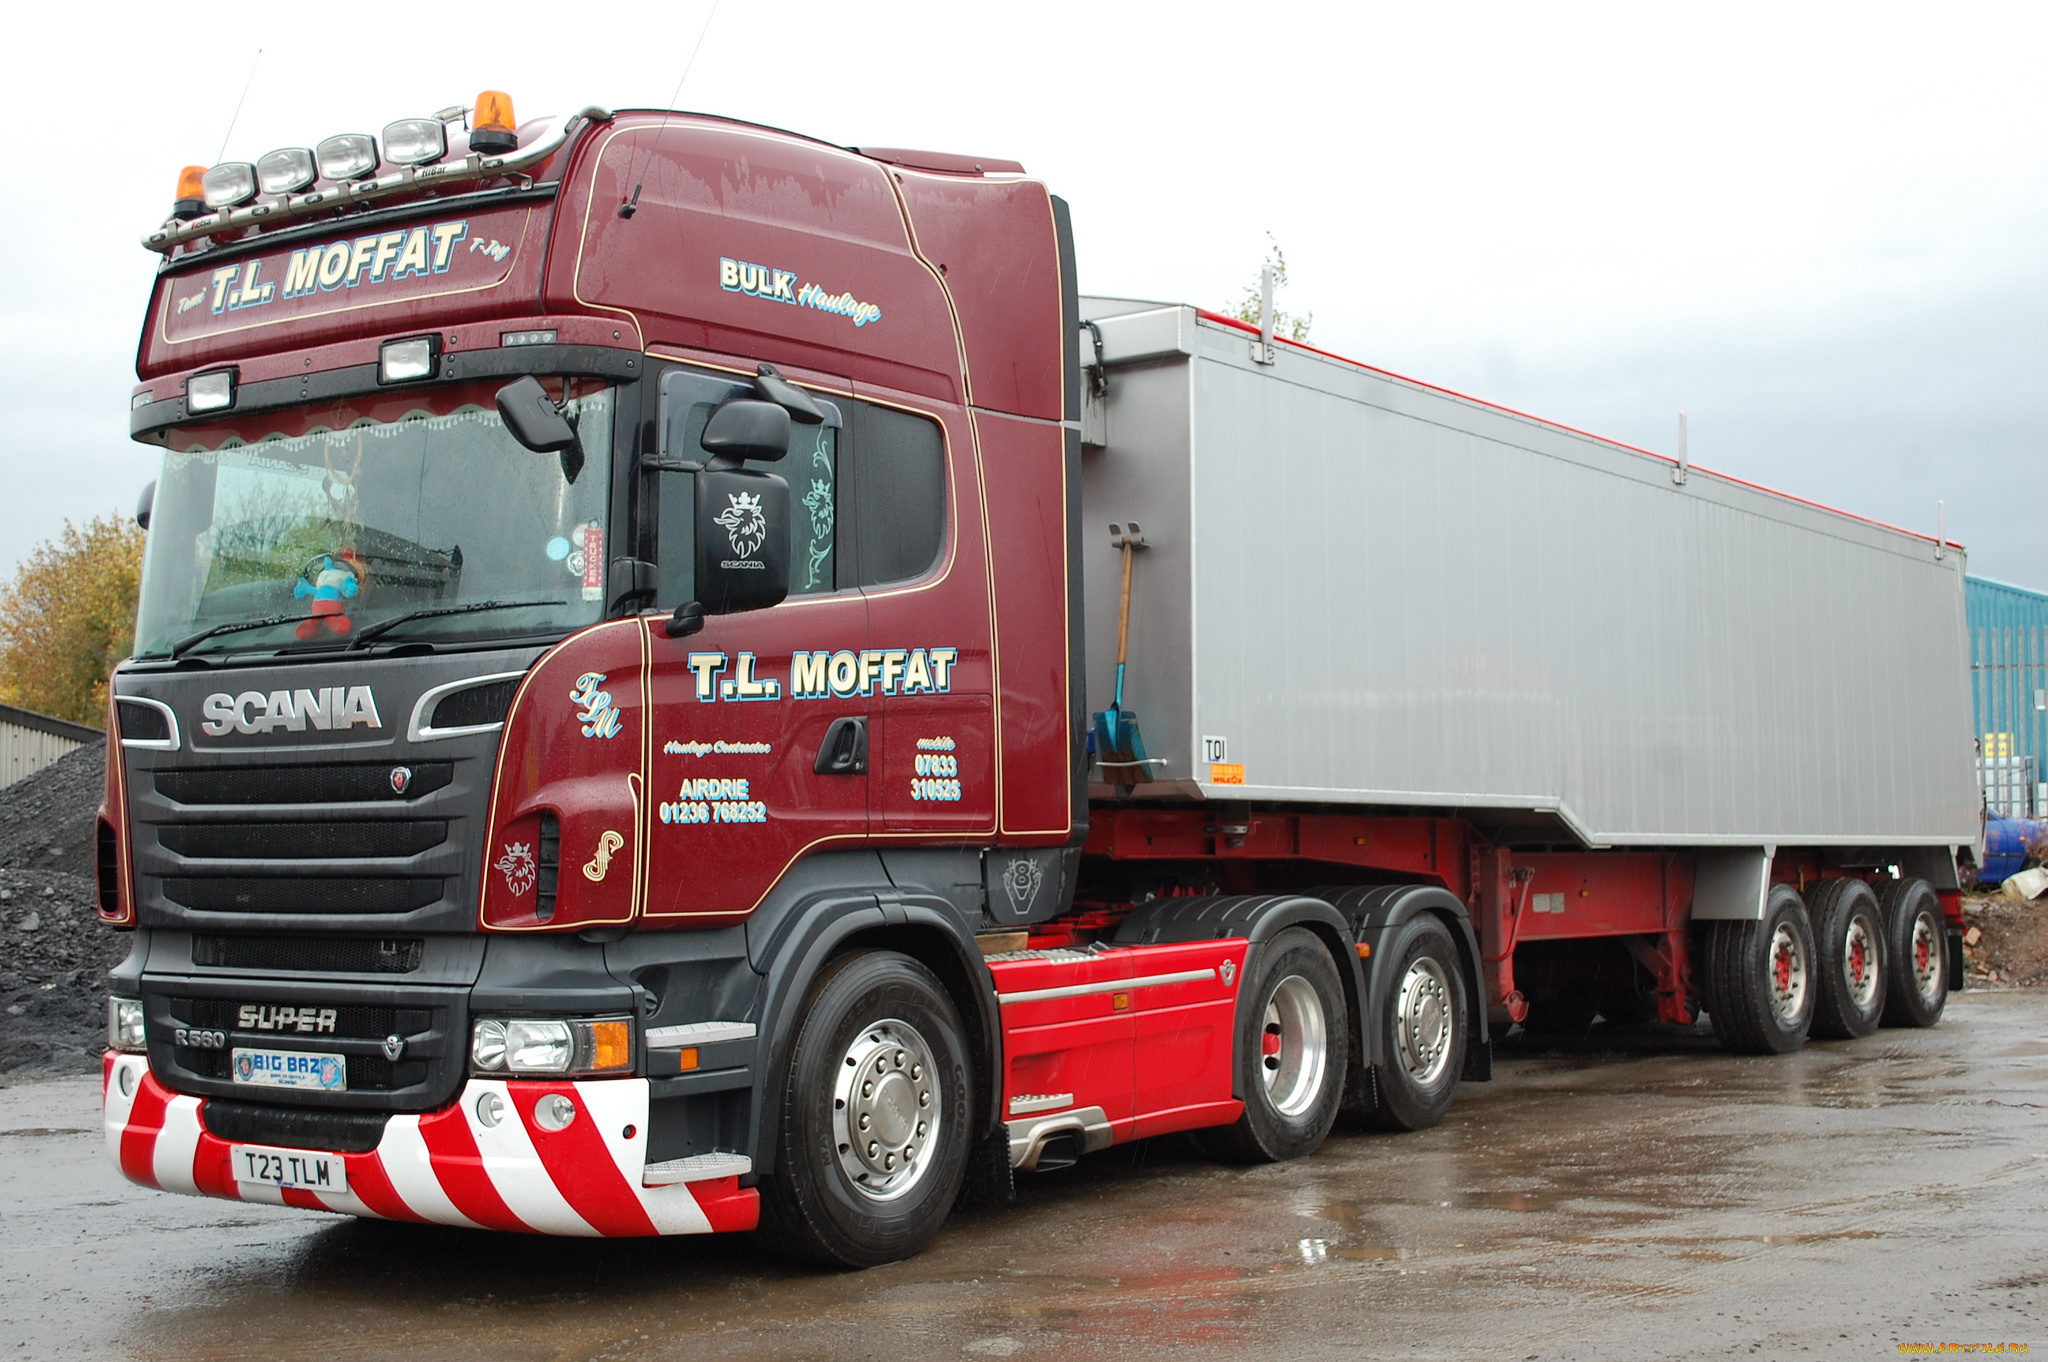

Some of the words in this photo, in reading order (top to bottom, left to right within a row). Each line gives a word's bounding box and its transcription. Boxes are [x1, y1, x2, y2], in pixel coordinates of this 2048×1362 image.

[212, 260, 276, 315] T.L.
[282, 220, 468, 299] MOFFAT
[720, 257, 797, 305] BULK
[798, 282, 881, 327] Haulage
[588, 534, 598, 583] TRUCKER
[720, 560, 766, 569] SCANIA
[688, 651, 781, 703] T.L.
[790, 646, 958, 699] MOFFAT
[202, 685, 382, 737] SCANIA
[916, 736, 956, 751] mobile
[914, 754, 958, 777] 07833
[679, 778, 750, 800] AIRDRIE
[910, 778, 961, 801] 310525
[659, 801, 710, 824] 01236
[711, 801, 767, 824] 768252
[238, 1004, 337, 1033] SUPER
[254, 1054, 281, 1071] BIG
[287, 1056, 320, 1074] BAZ
[245, 1152, 284, 1181] T23
[288, 1157, 330, 1186] TLM
